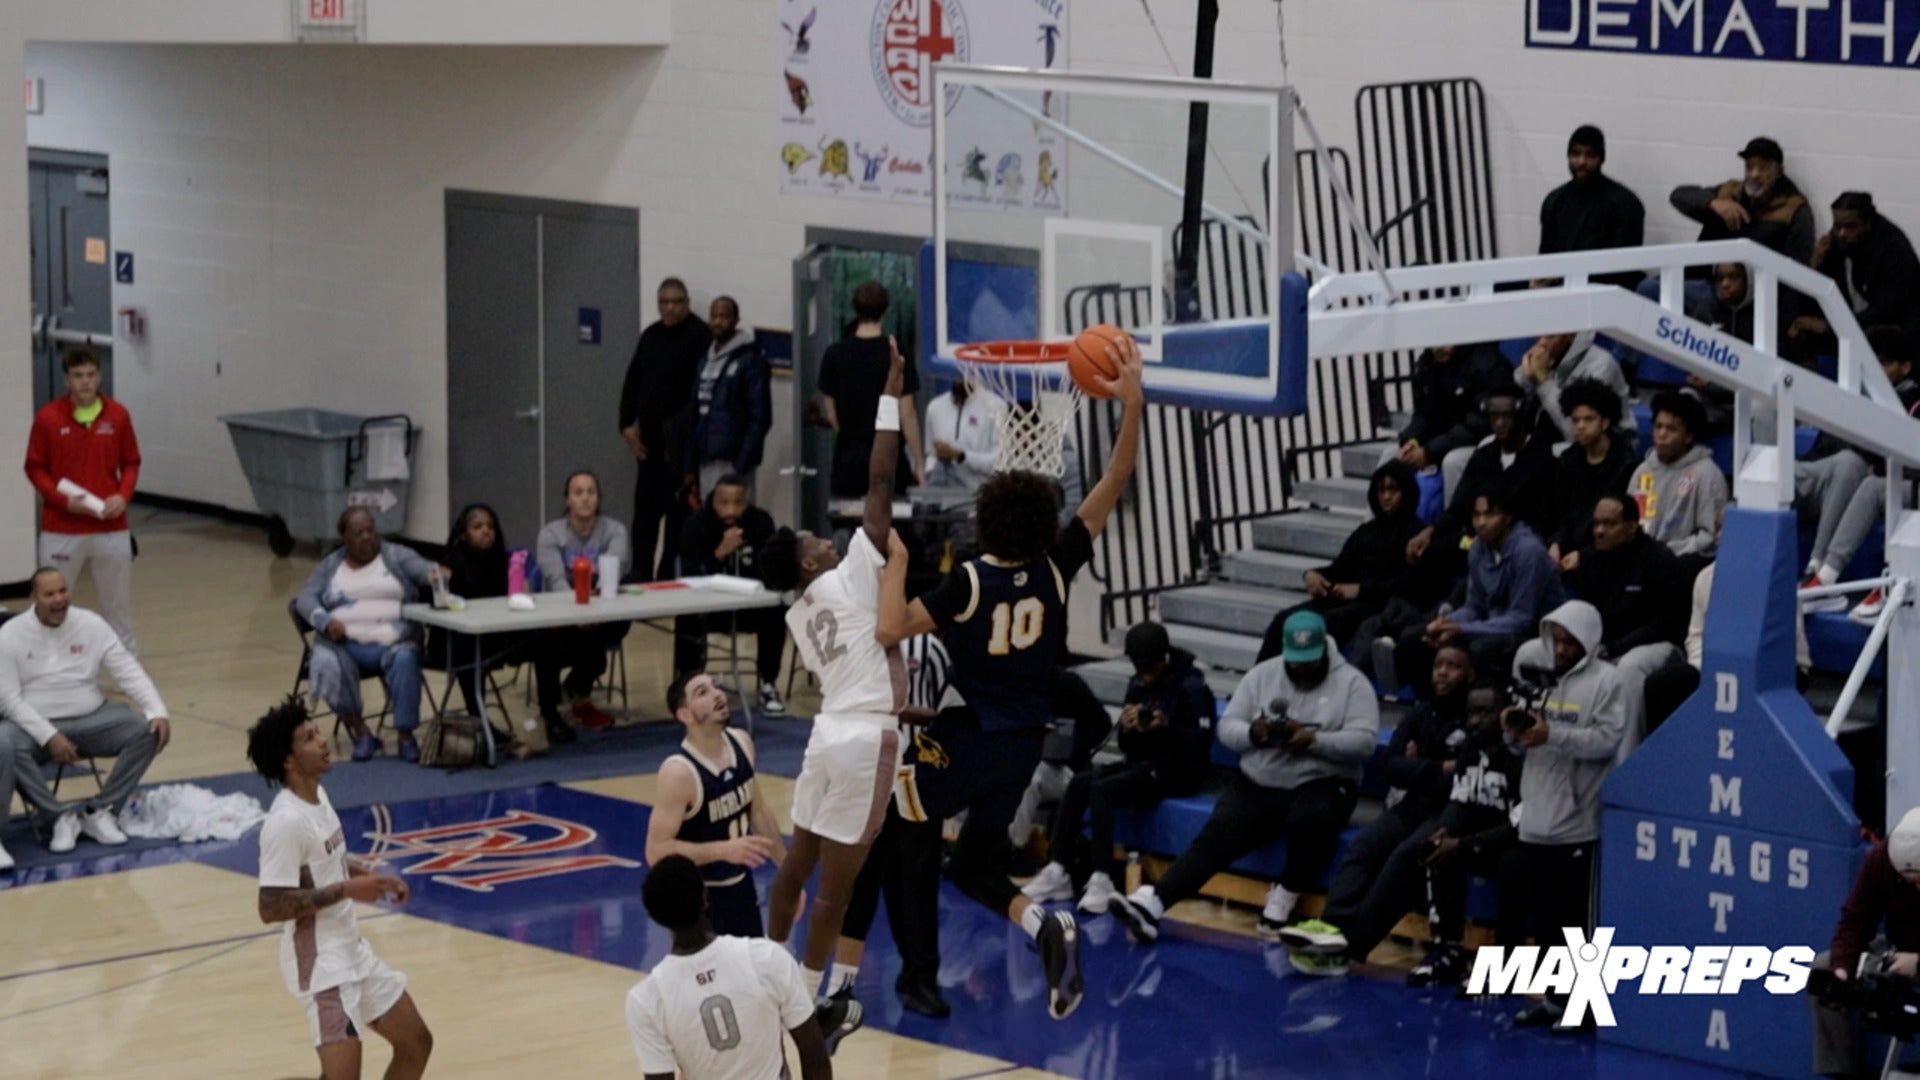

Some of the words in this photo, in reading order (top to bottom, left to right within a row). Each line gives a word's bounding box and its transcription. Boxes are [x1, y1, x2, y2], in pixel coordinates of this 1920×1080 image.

[1656, 316, 1740, 371] Schelde
[805, 608, 849, 667] 12
[987, 595, 1045, 656] 10
[708, 777, 754, 823] HIGHLAN
[1636, 820, 1810, 890] STAGS
[1706, 672, 1742, 1051] DEMATA
[699, 993, 742, 1053] 0
